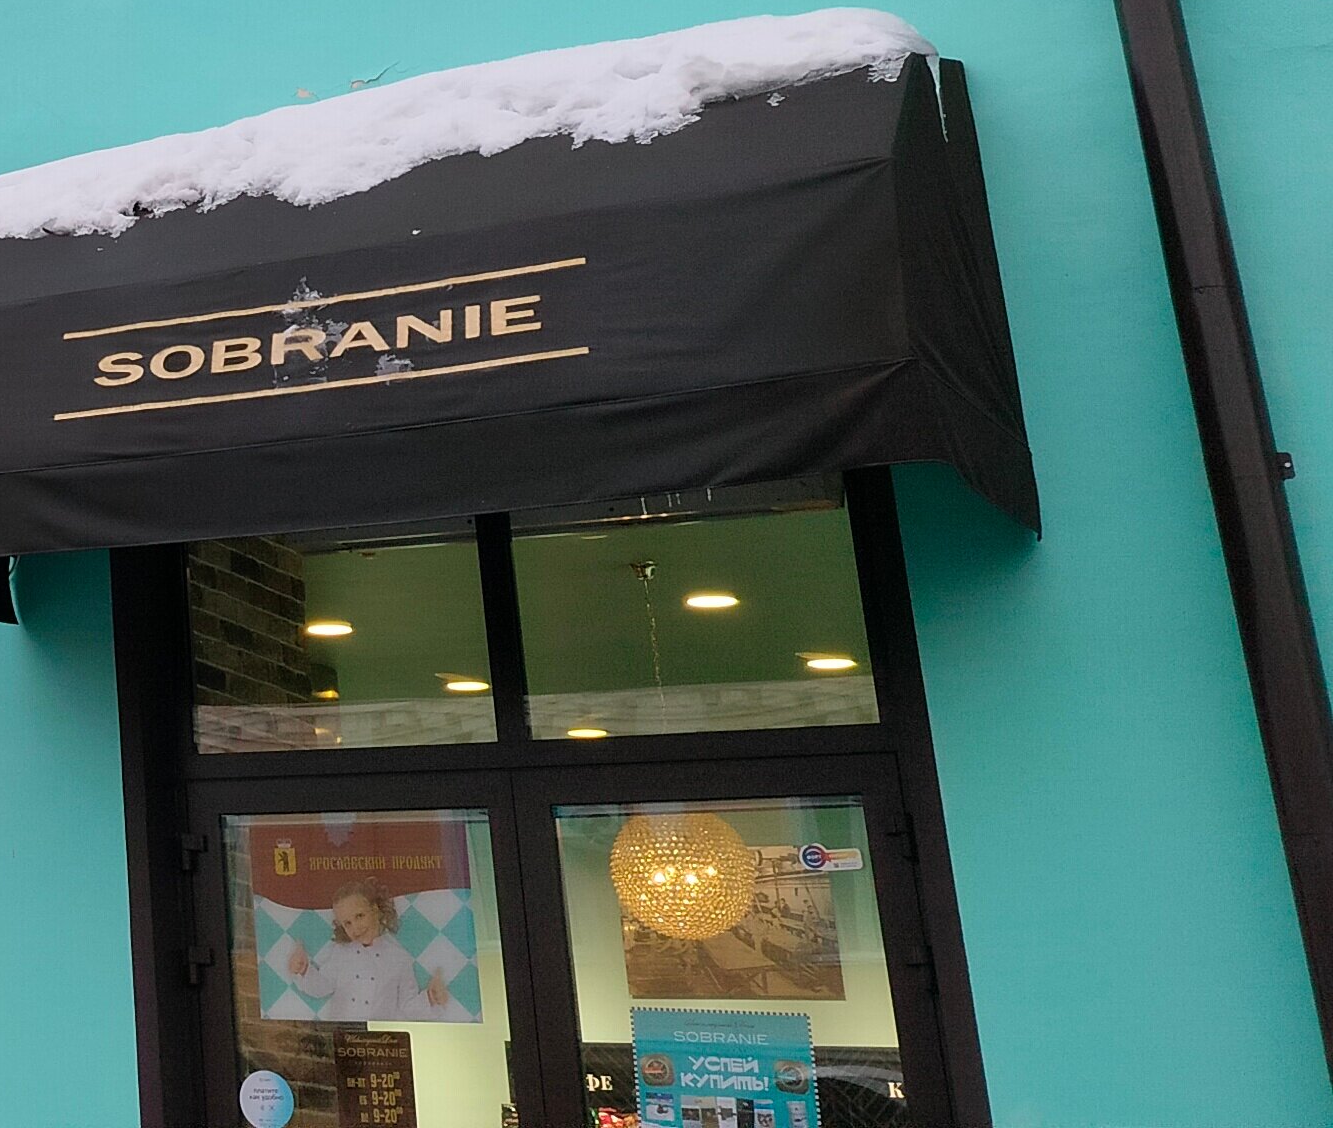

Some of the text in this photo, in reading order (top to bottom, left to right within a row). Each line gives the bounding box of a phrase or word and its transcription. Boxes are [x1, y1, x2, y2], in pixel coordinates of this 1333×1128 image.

[93, 294, 542, 387] SOBRANIE
[673, 1030, 769, 1045] SOBRANIE
[337, 1047, 408, 1057] SOBRANIE
[688, 1055, 760, 1073] УСПЕЙ
[680, 1072, 769, 1091] КУПИТЬ!
